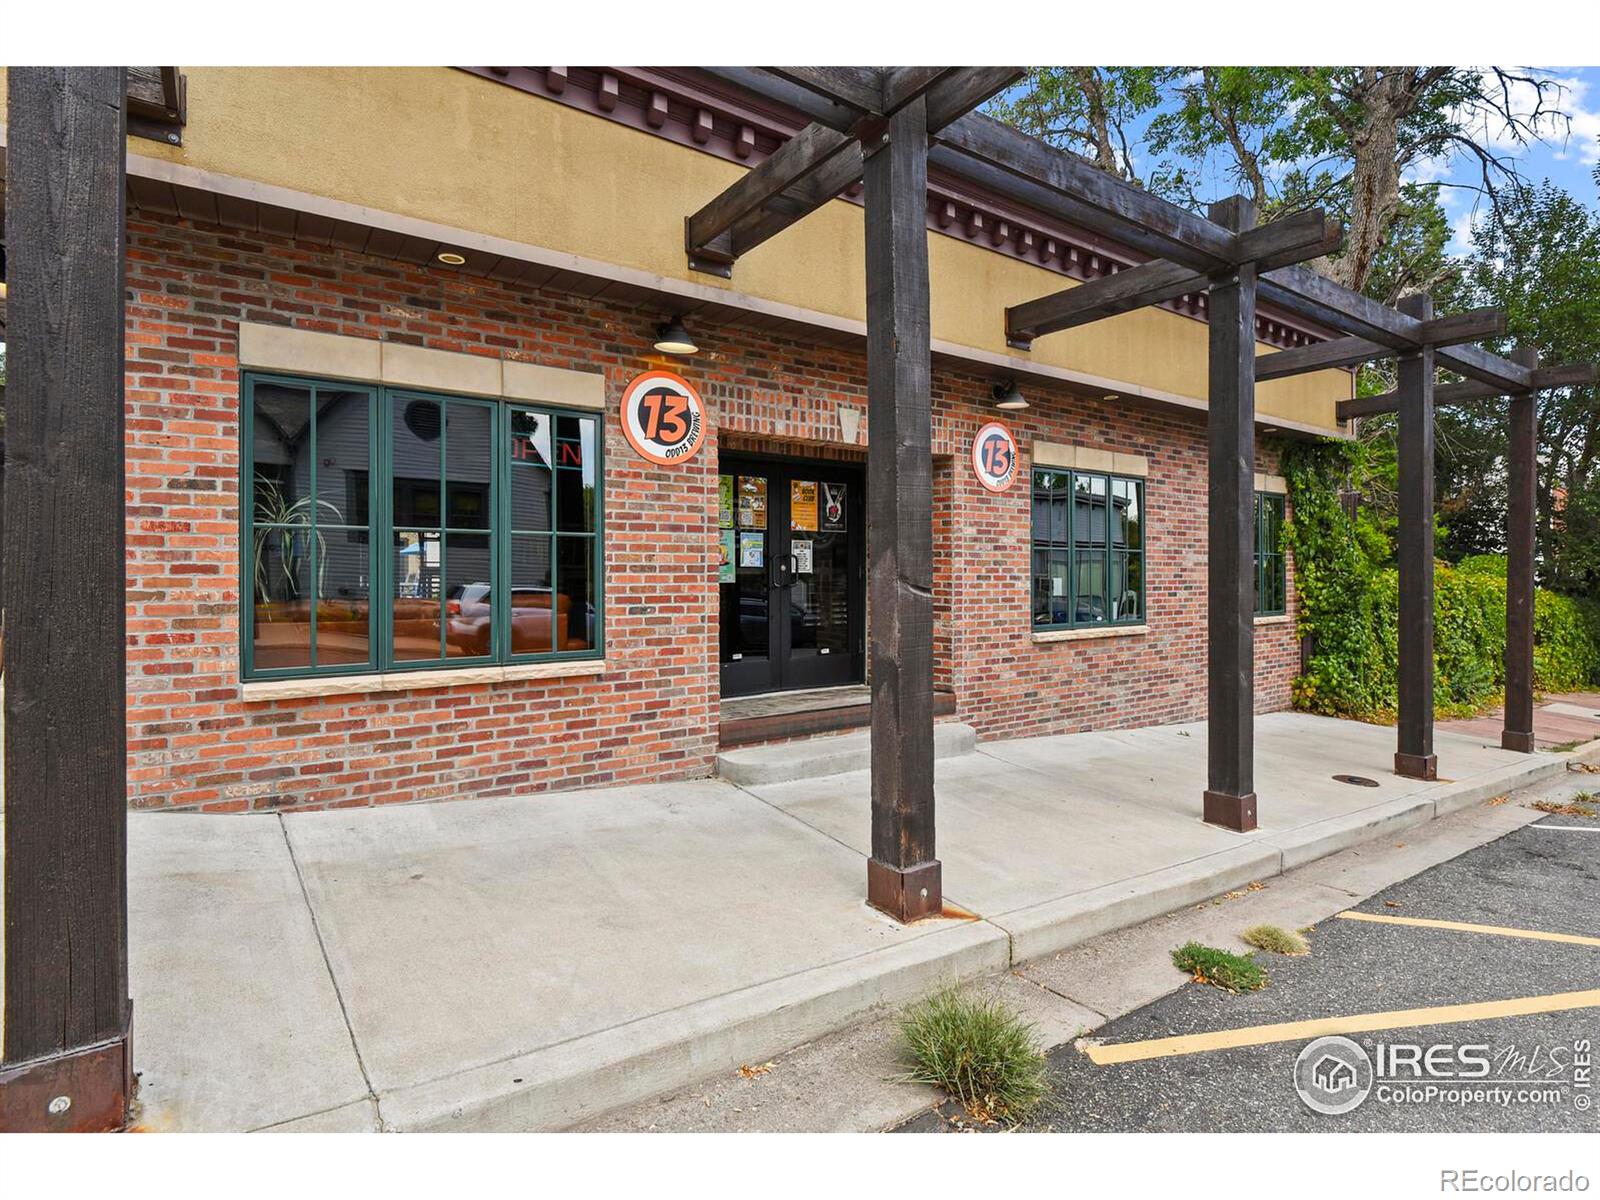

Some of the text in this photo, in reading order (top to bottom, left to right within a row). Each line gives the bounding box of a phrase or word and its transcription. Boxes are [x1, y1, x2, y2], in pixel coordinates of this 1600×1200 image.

[643, 394, 689, 443] 13
[665, 411, 701, 458] ODD13 BREWING
[984, 440, 1009, 475] 13
